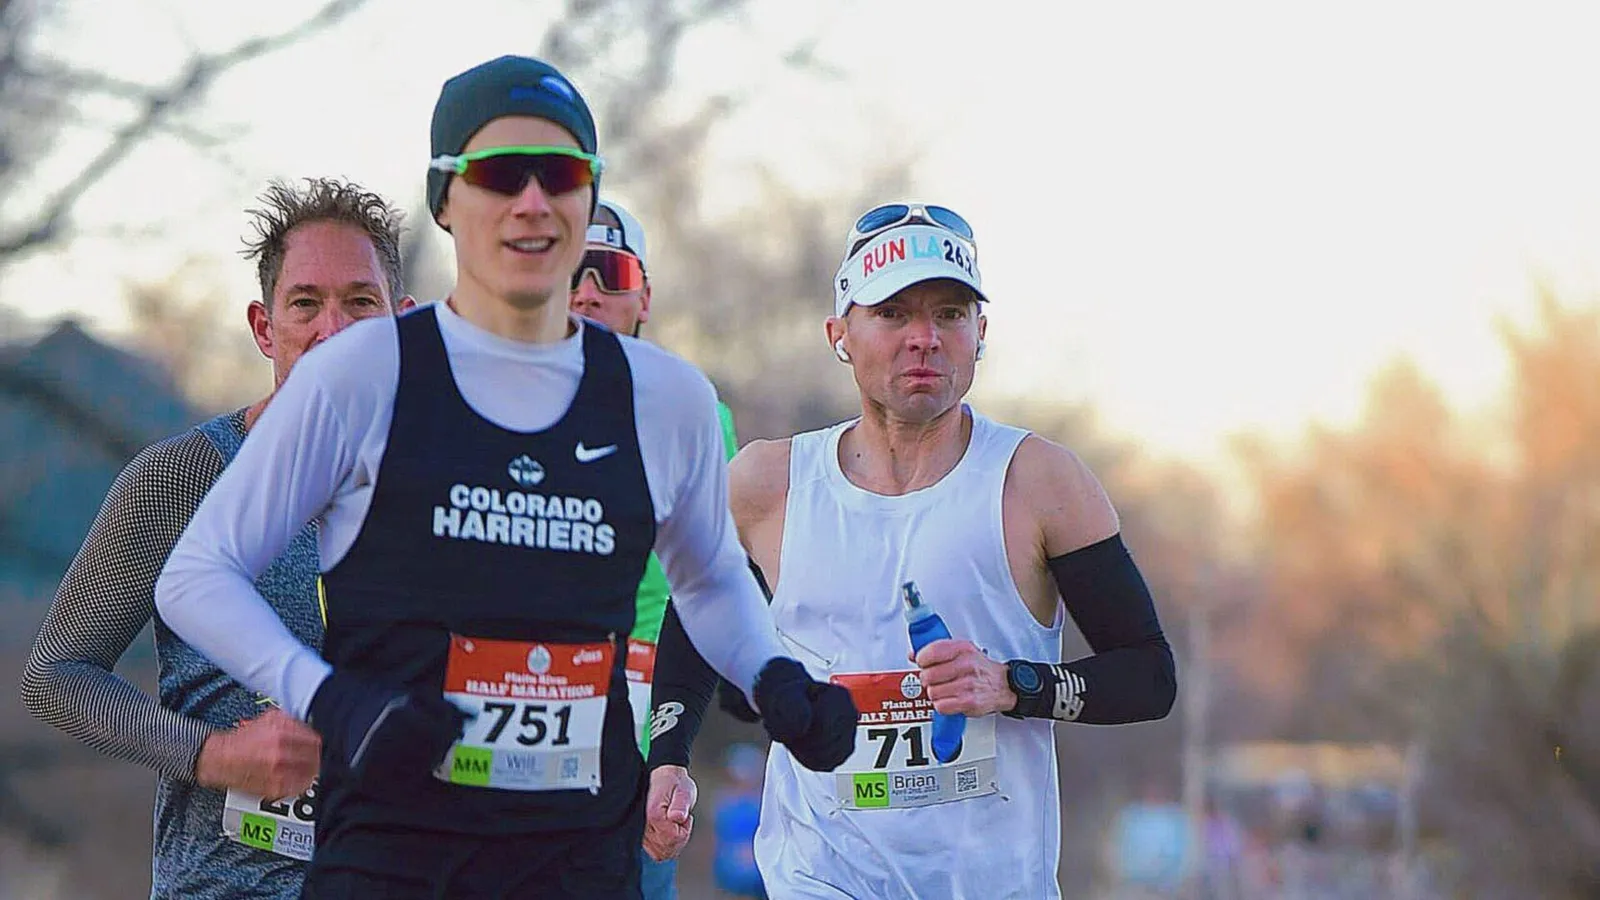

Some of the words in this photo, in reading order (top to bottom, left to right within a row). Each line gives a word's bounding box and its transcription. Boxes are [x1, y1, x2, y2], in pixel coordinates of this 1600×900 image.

[863, 237, 906, 278] RUN
[911, 235, 943, 261] LA
[449, 483, 604, 524] COLORADO
[432, 505, 617, 556] HARRIERS
[465, 679, 509, 696] HALF
[510, 683, 596, 700] MARATHON
[914, 698, 933, 708] Riv
[483, 701, 572, 747] 751
[857, 711, 889, 723] ALF
[453, 756, 490, 774] MM
[855, 781, 886, 799] MS
[894, 774, 936, 789] Brian
[243, 822, 273, 844] MS
